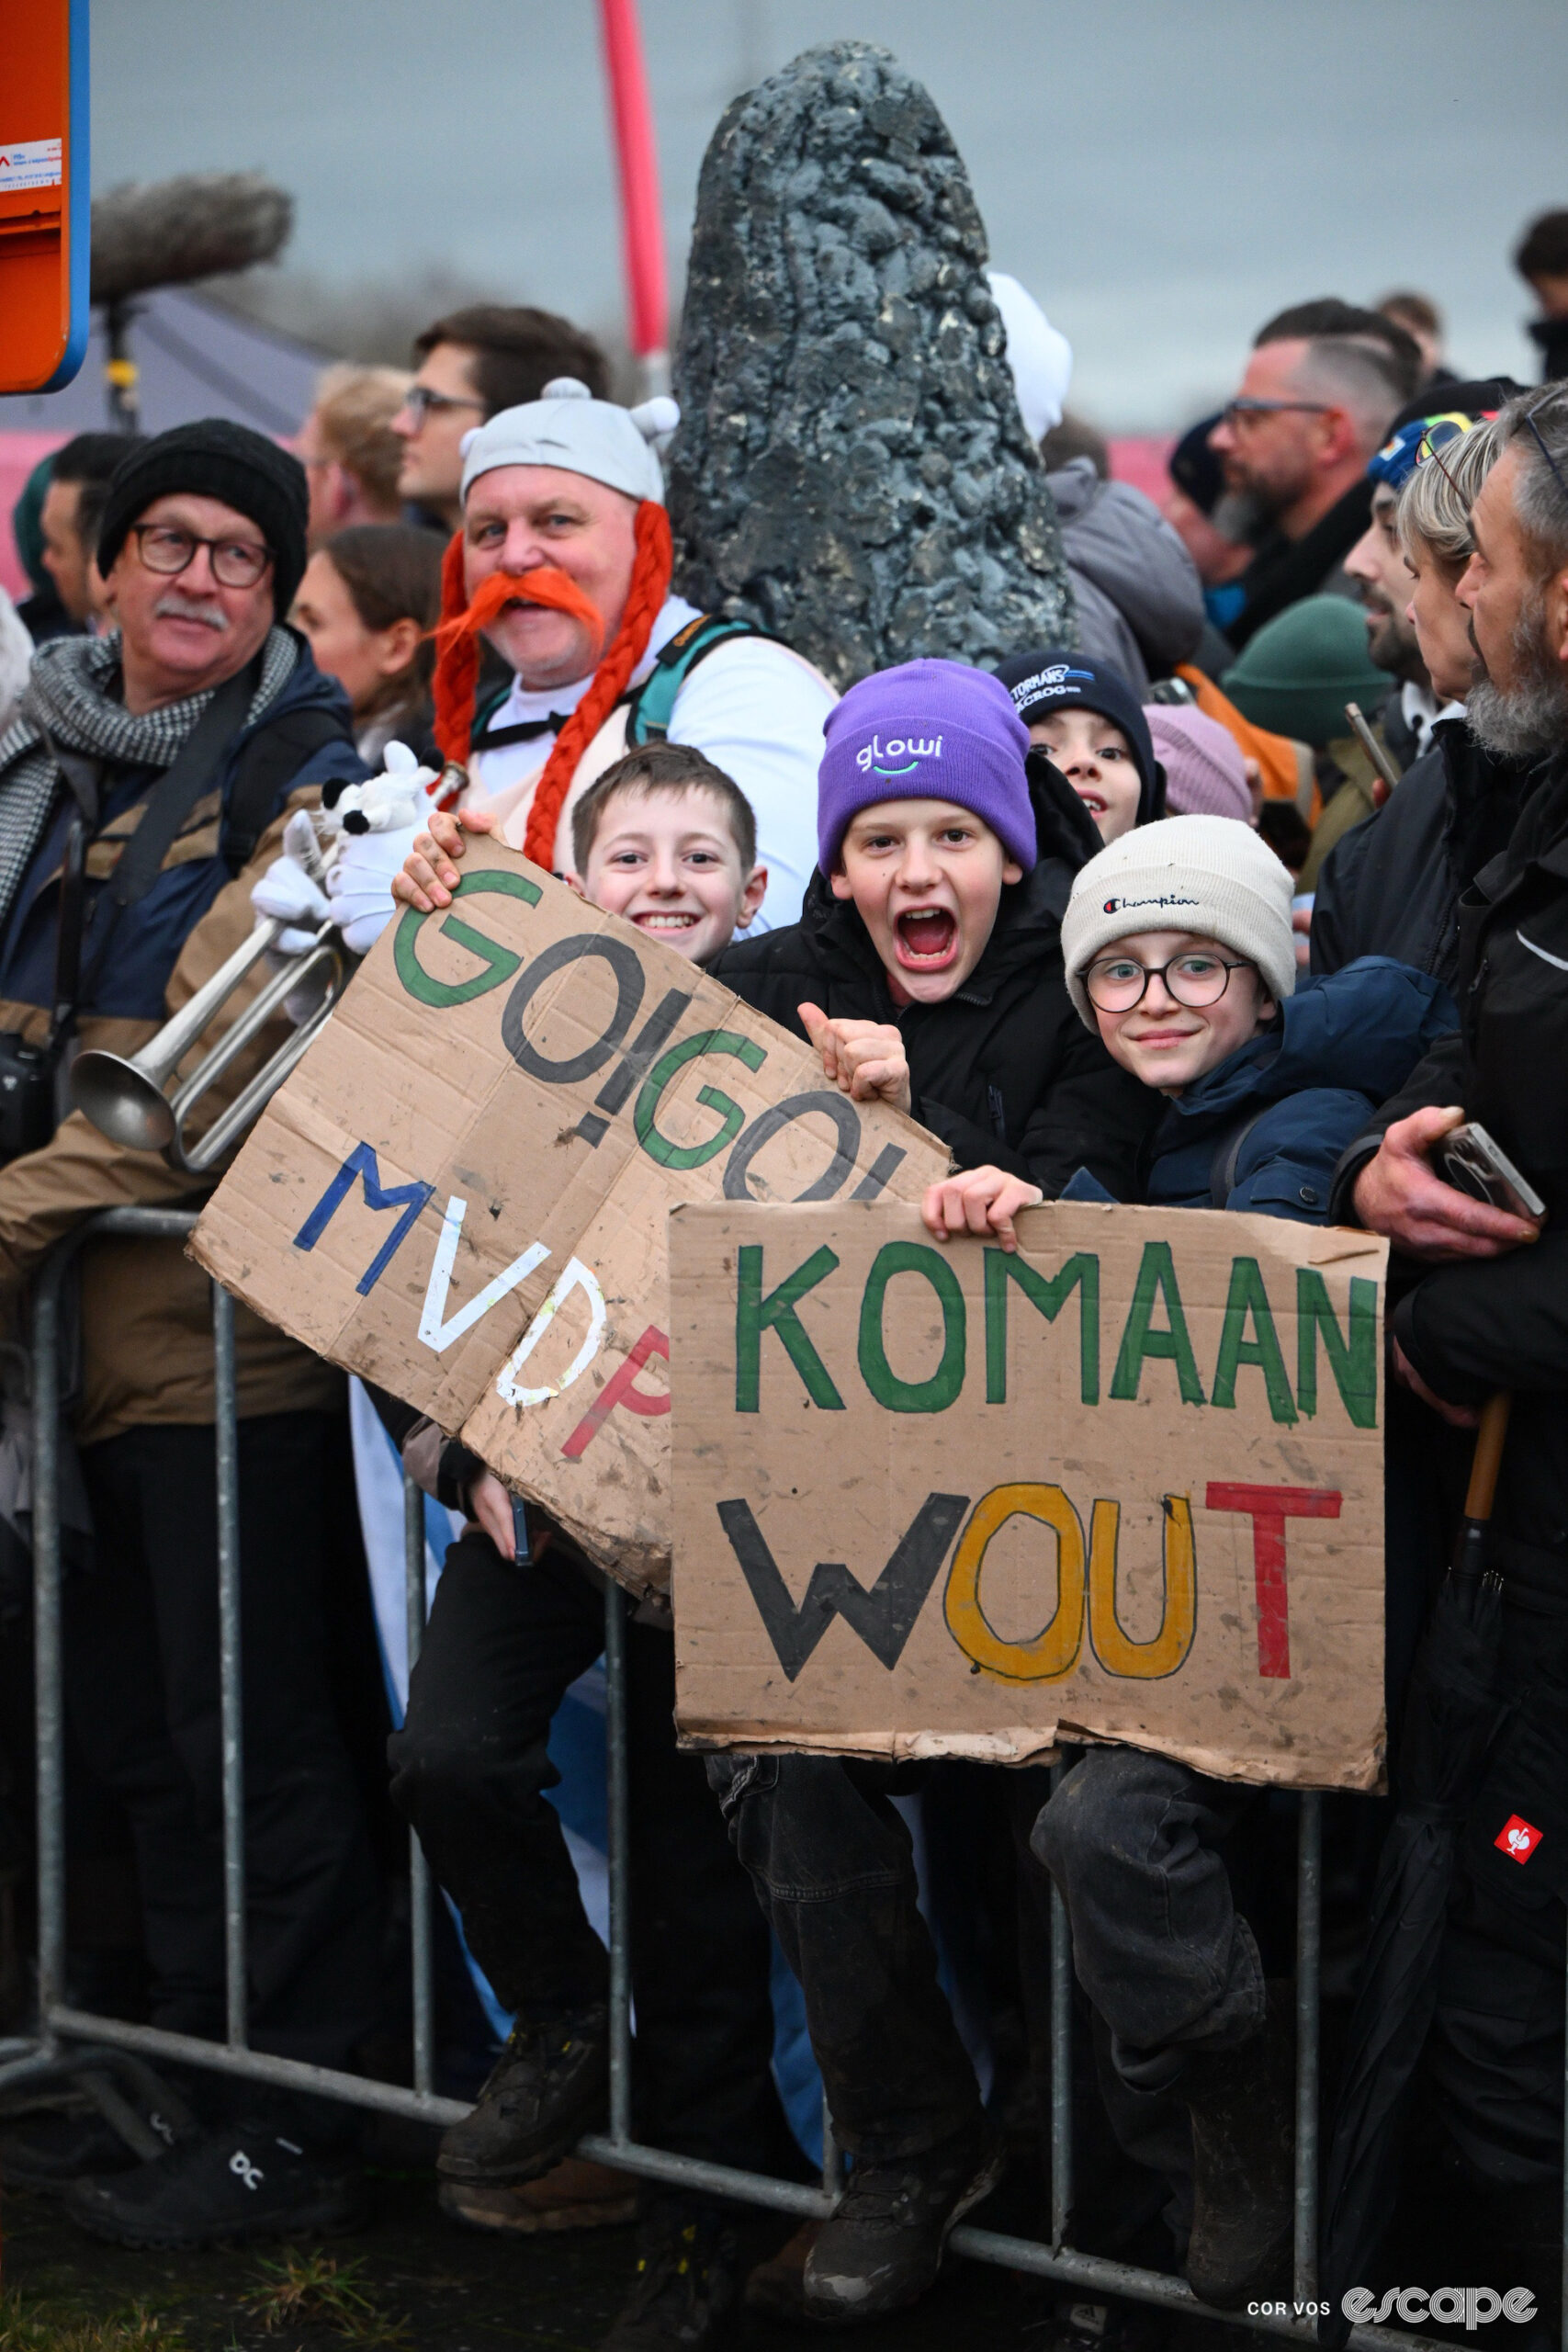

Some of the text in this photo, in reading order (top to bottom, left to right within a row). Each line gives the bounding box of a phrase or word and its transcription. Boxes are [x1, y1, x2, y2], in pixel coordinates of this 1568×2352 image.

[1010, 665, 1068, 701] TORMANS
[856, 734, 943, 772] glowi
[1103, 894, 1200, 914] Champion
[735, 1240, 1379, 1429] KOMAAN
[716, 1481, 1343, 1685] WOUT
